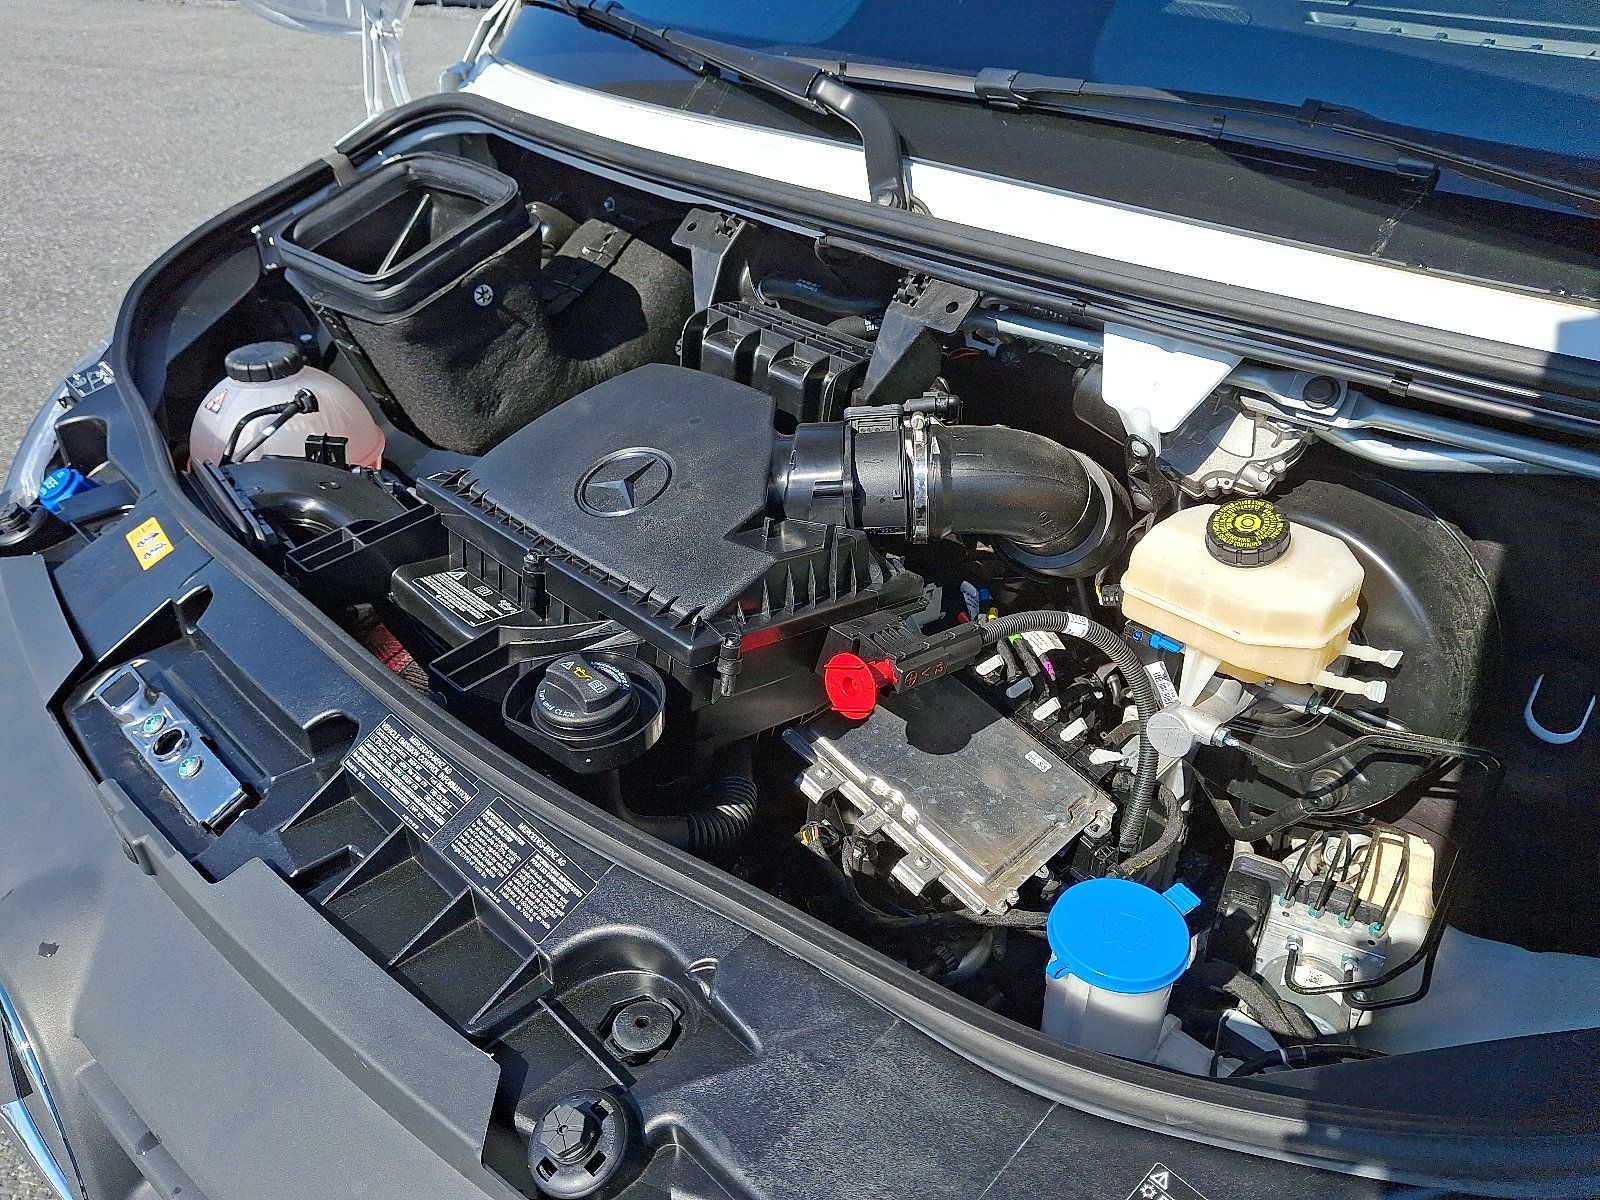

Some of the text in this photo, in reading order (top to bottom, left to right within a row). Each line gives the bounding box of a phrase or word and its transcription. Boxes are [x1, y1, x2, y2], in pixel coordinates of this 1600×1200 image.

[555, 708, 576, 718] CLICK
[380, 721, 471, 802] VEHICLE EMISSION CONTROL INFORMATION
[408, 735, 453, 775] MERCEDES-BENZ AG
[516, 821, 568, 868] MERCEDES-BENZ AG
